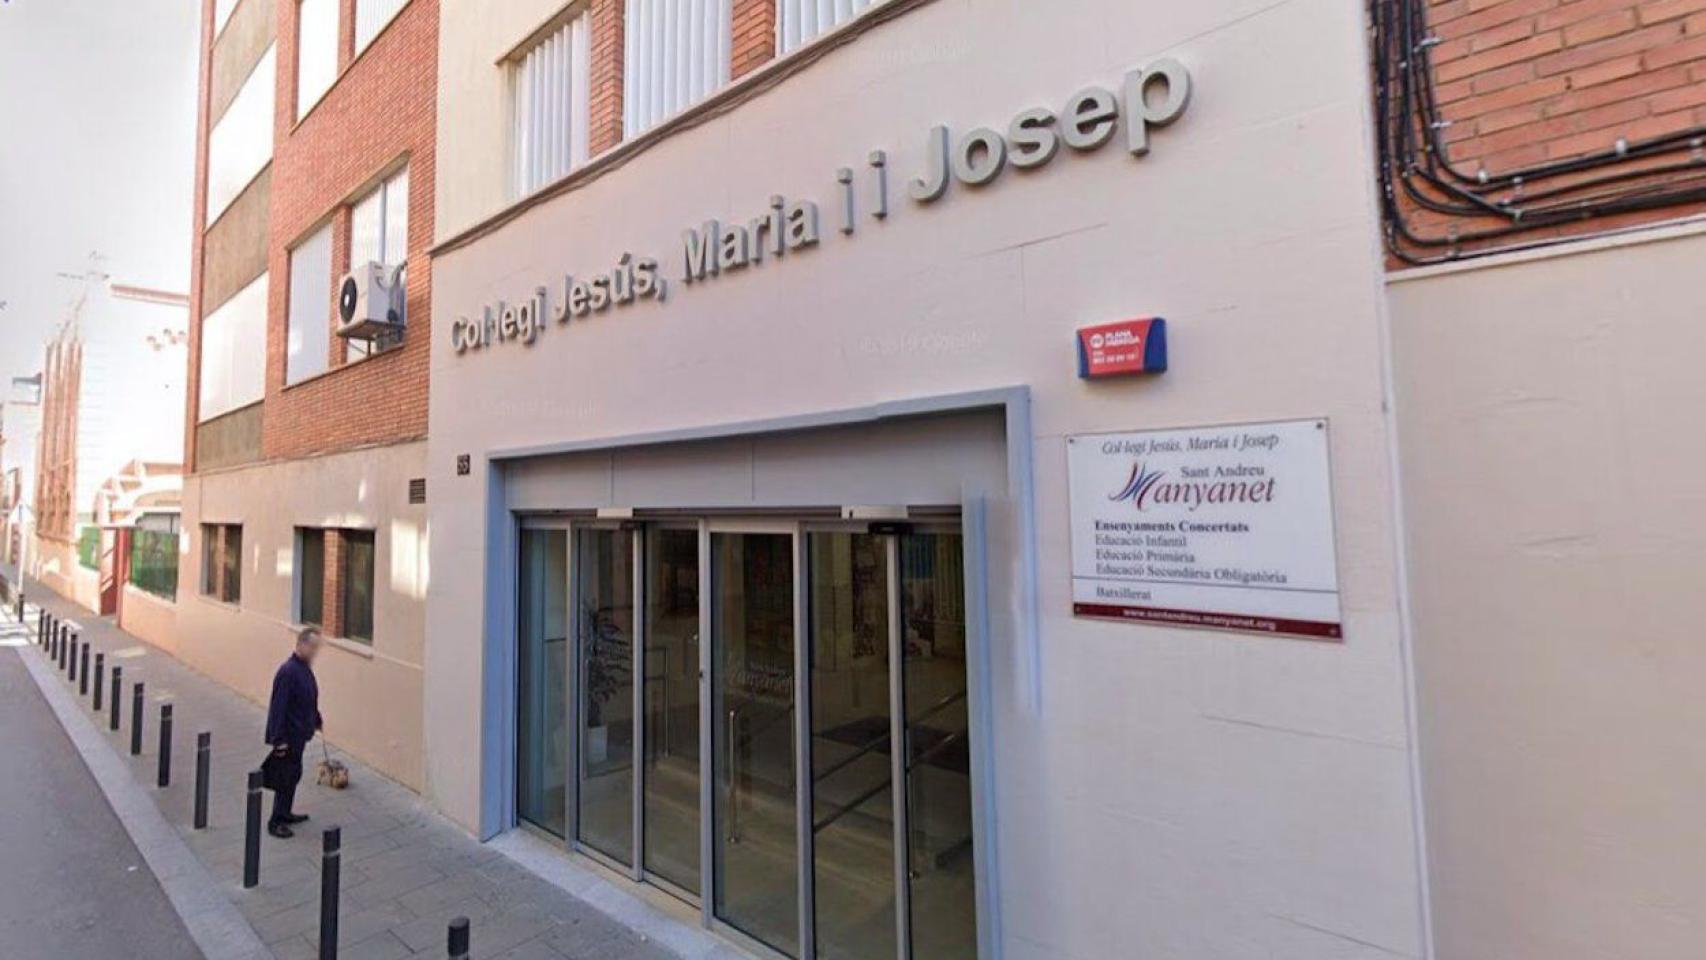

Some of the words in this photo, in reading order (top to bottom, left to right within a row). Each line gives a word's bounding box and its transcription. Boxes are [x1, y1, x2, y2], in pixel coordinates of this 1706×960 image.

[555, 253, 667, 323] Jesús,
[681, 195, 820, 284] Maria
[836, 167, 853, 235] i
[868, 150, 887, 220] i
[908, 57, 1192, 203] Josep
[1184, 436, 1229, 451] Maria
[1233, 436, 1238, 448] i
[1238, 433, 1279, 451] Josep
[1181, 465, 1210, 478] Sant
[1214, 463, 1265, 478] Andreu
[1095, 520, 1175, 534] Ensenyaments
[1179, 520, 1249, 532] Concertats
[1095, 533, 1144, 546] Educació
[1146, 535, 1187, 547] Infantil
[1096, 548, 1144, 561] Educació
[1147, 550, 1195, 563] Primària
[1096, 563, 1145, 576] Educació
[1147, 565, 1211, 579] Secundària
[1214, 568, 1287, 583] Obligatòria
[1097, 587, 1151, 600] Batxillerat
